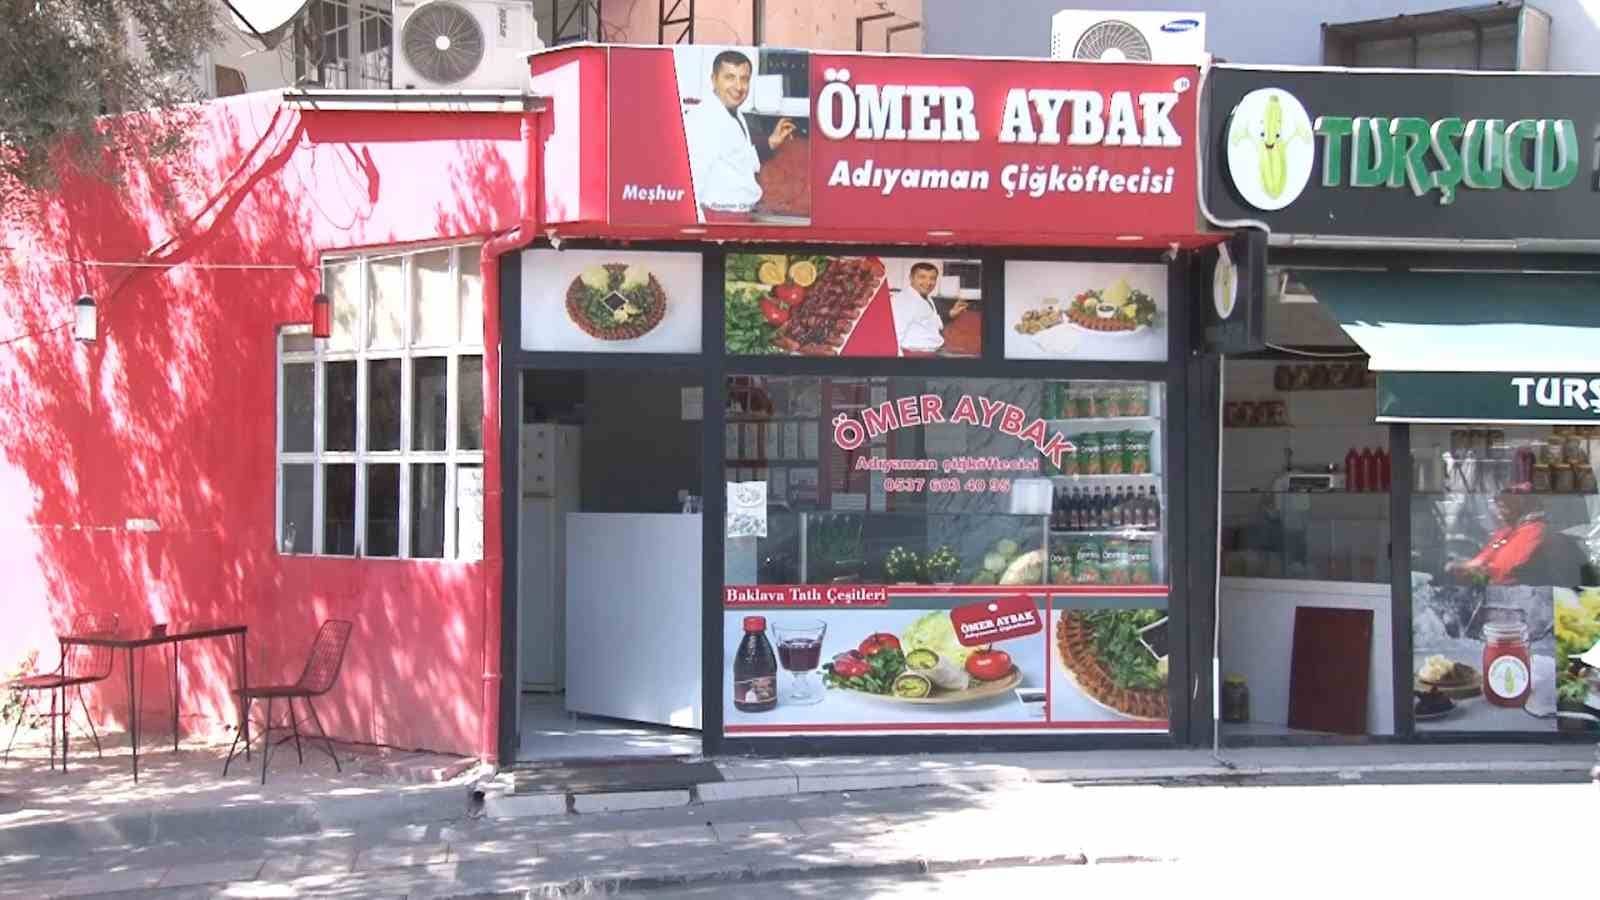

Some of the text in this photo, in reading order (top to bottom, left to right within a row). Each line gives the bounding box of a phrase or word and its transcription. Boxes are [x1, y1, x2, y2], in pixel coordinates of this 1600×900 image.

[817, 68, 1183, 148] ÖMER AYBAK
[828, 160, 1176, 198] Adıyaman Çiğköftecisi
[1314, 115, 1580, 206] TURŞUCU
[622, 183, 686, 205] Meşhur
[832, 393, 1078, 470] ÖMER AYBAK
[726, 588, 785, 603] Baklava
[826, 587, 887, 605] Çeşitleri
[995, 611, 1035, 627] AYBAK
